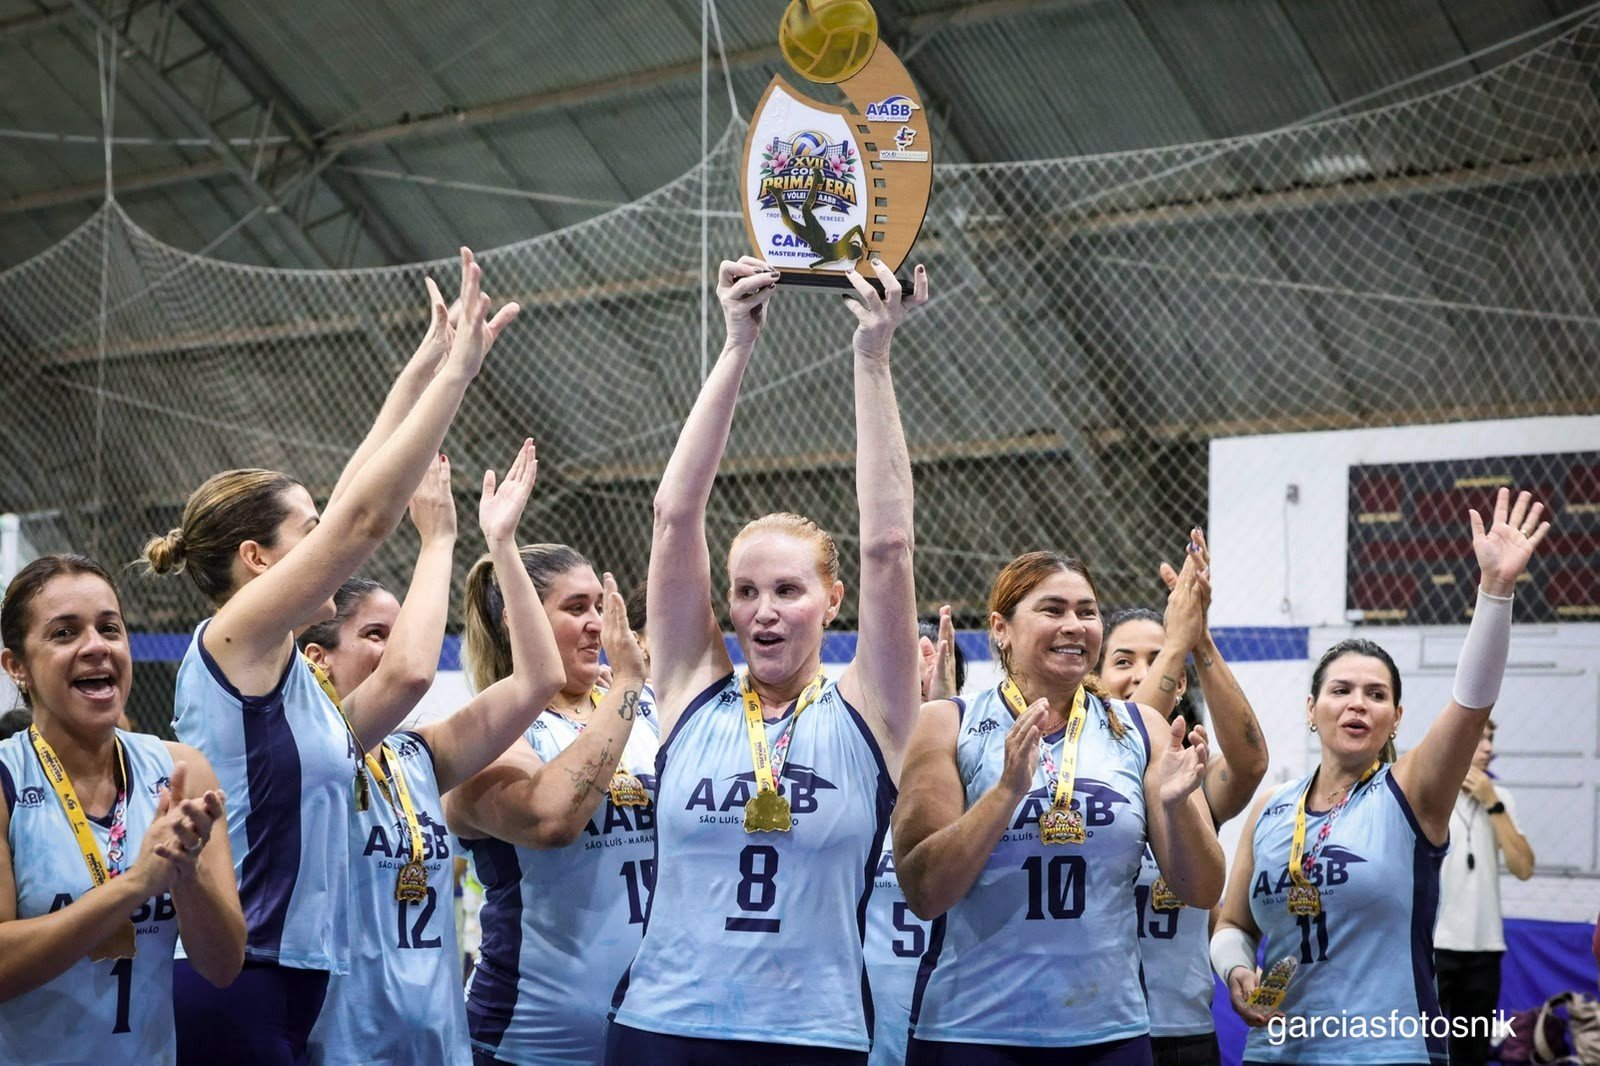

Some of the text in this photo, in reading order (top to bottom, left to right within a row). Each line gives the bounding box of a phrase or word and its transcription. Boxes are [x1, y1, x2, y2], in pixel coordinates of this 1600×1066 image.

[866, 104, 910, 115] AABB
[793, 157, 825, 168] XVII
[768, 249, 796, 257] MASTER
[699, 815, 717, 824] SÃO
[719, 815, 739, 824] LUÍS
[585, 840, 602, 850] SÃO
[604, 836, 623, 847] LUÍS
[1013, 832, 1034, 842] LUÍS
[736, 845, 779, 912] 8
[1021, 855, 1087, 920] 10
[396, 887, 442, 948] 12
[892, 902, 926, 957] 5
[1296, 911, 1329, 964] 11
[110, 958, 132, 1034] 1
